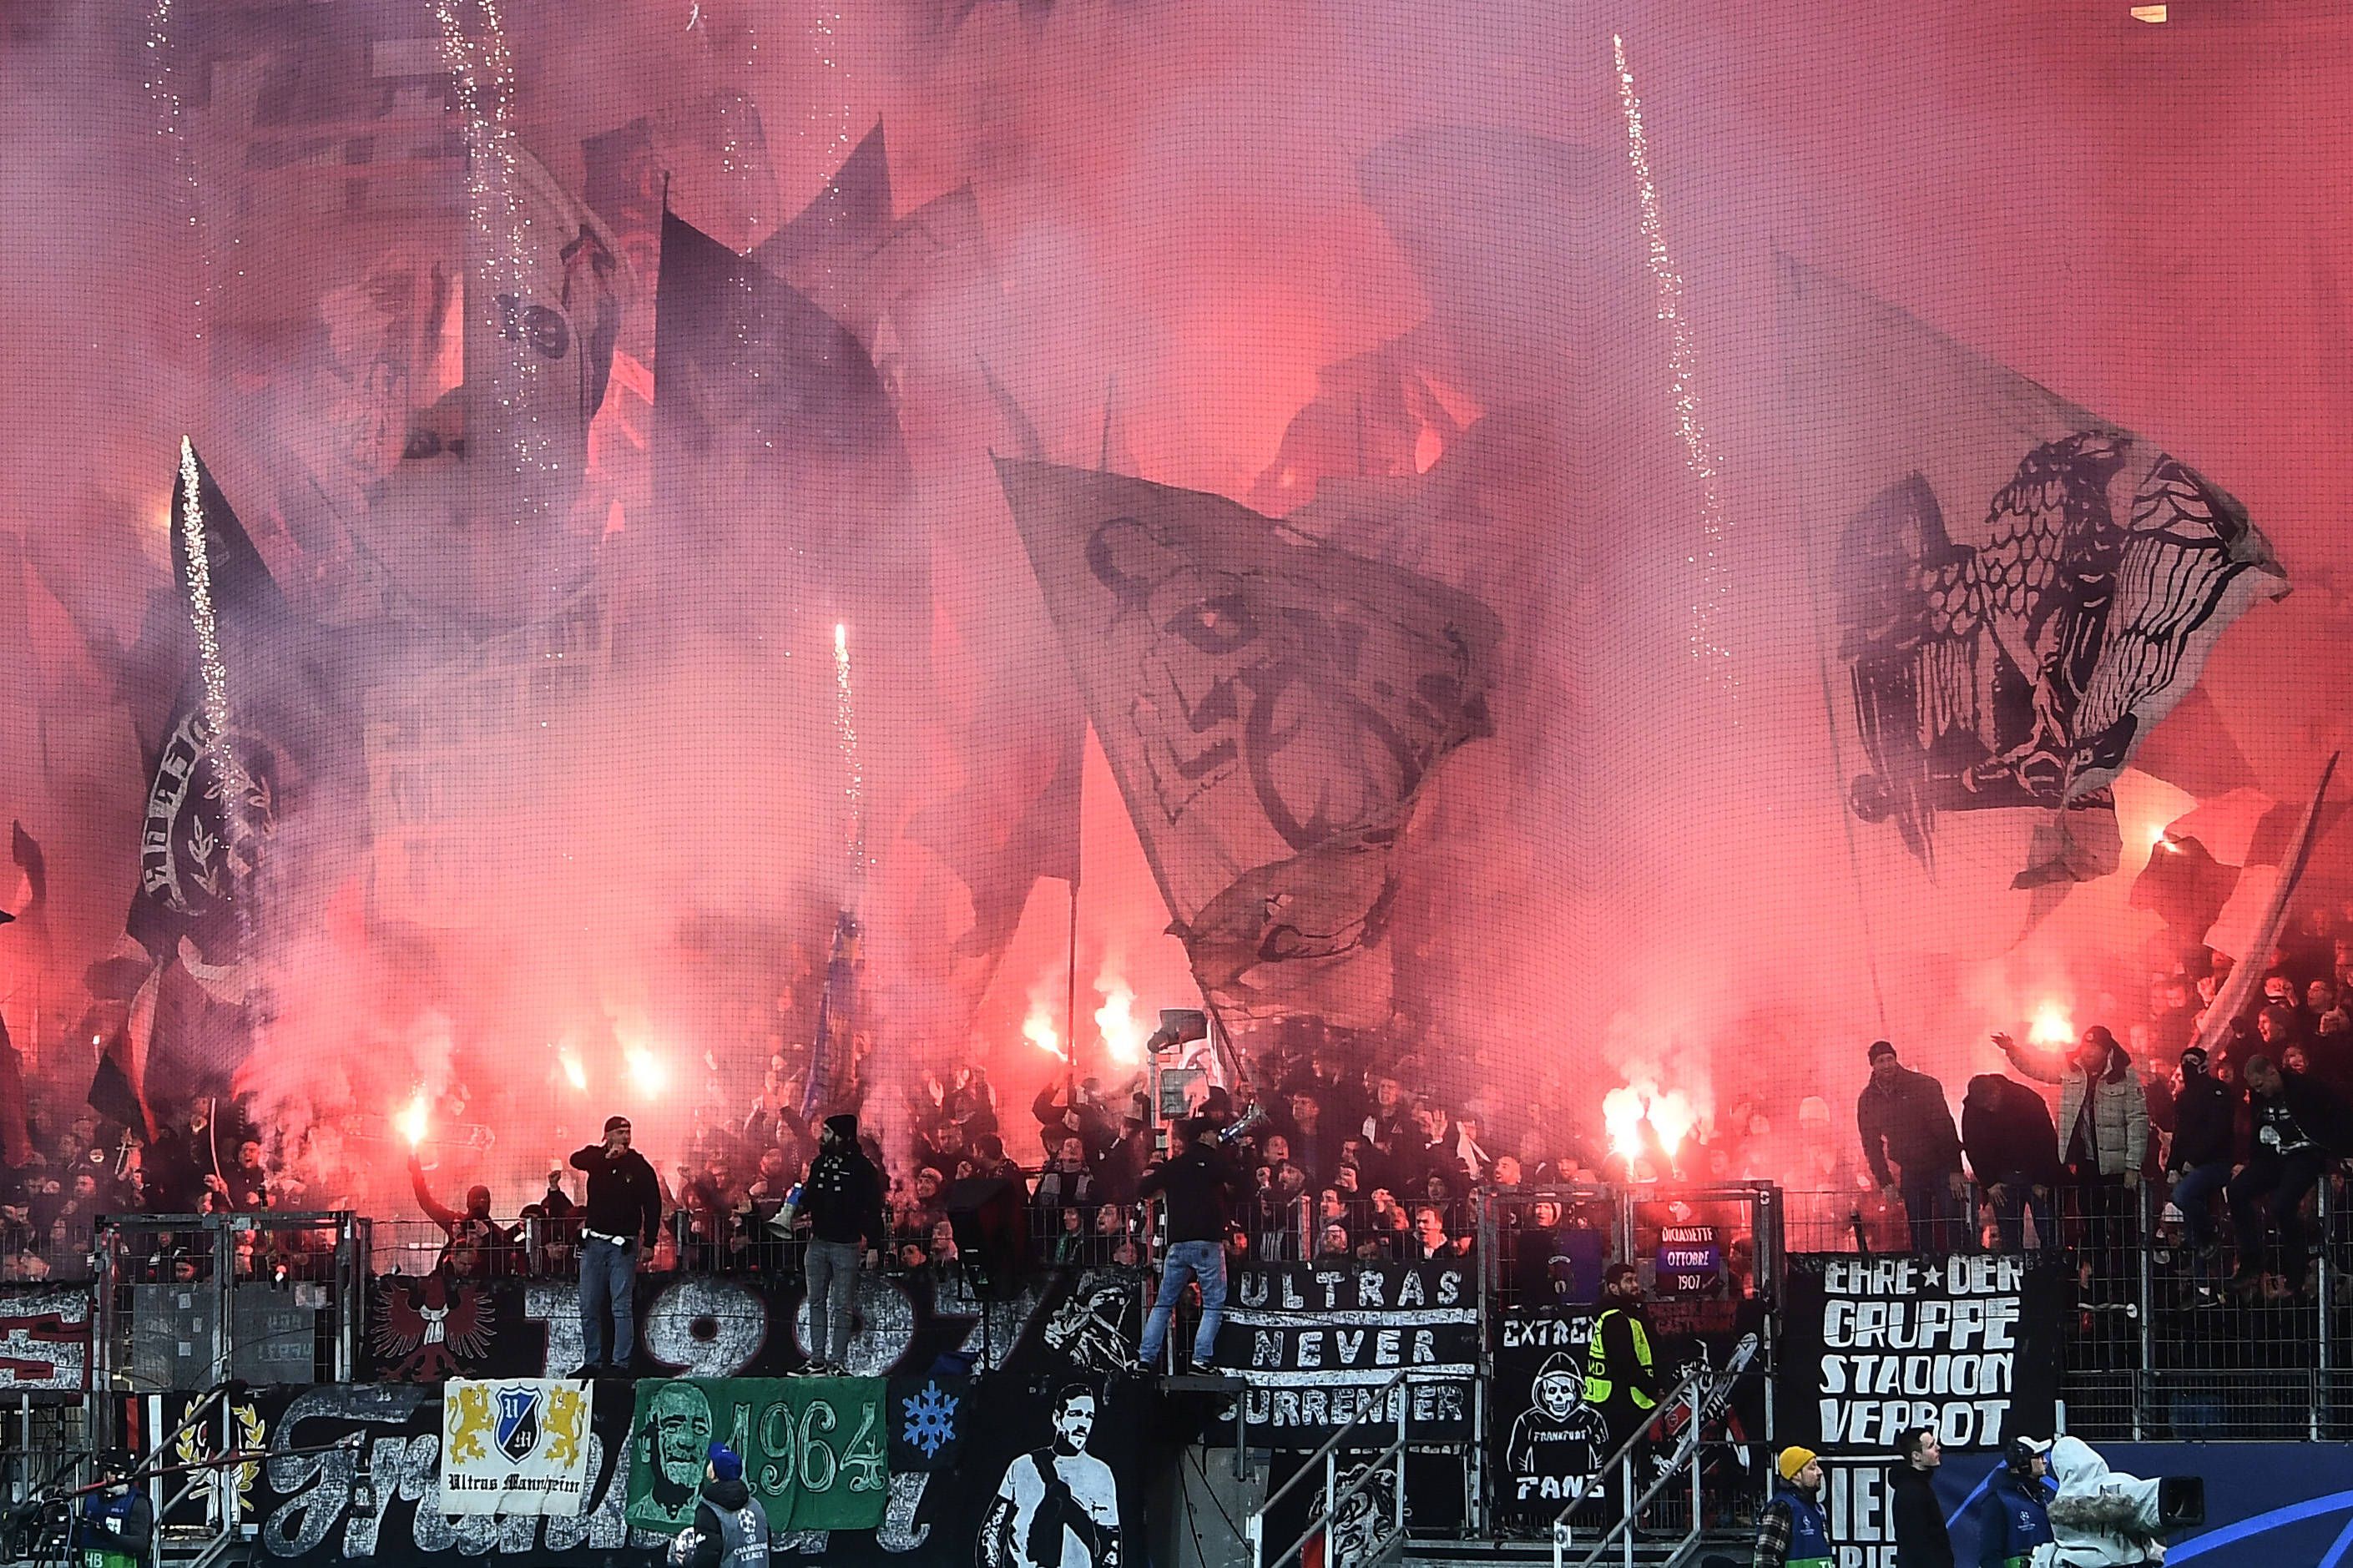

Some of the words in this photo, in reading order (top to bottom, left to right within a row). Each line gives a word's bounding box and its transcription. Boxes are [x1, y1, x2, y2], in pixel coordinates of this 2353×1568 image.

[1667, 1251, 1709, 1266] OTTOBRE
[1825, 1258, 1919, 1294] EHRE
[1947, 1254, 2023, 1294] DER
[1240, 1269, 1462, 1308] ULTRAS
[1678, 1274, 1700, 1290] 1907
[1824, 1297, 2020, 1349] GRUPPE
[1252, 1329, 1436, 1367] NEVER
[1819, 1353, 2014, 1395] STADION
[1533, 1429, 1587, 1442] FRANKFURT
[1819, 1399, 2011, 1445] VERBOT
[723, 1399, 886, 1495] 1964
[448, 1474, 497, 1490] Ultras
[502, 1474, 579, 1495] Mannheim
[1517, 1475, 1604, 1500] FANS
